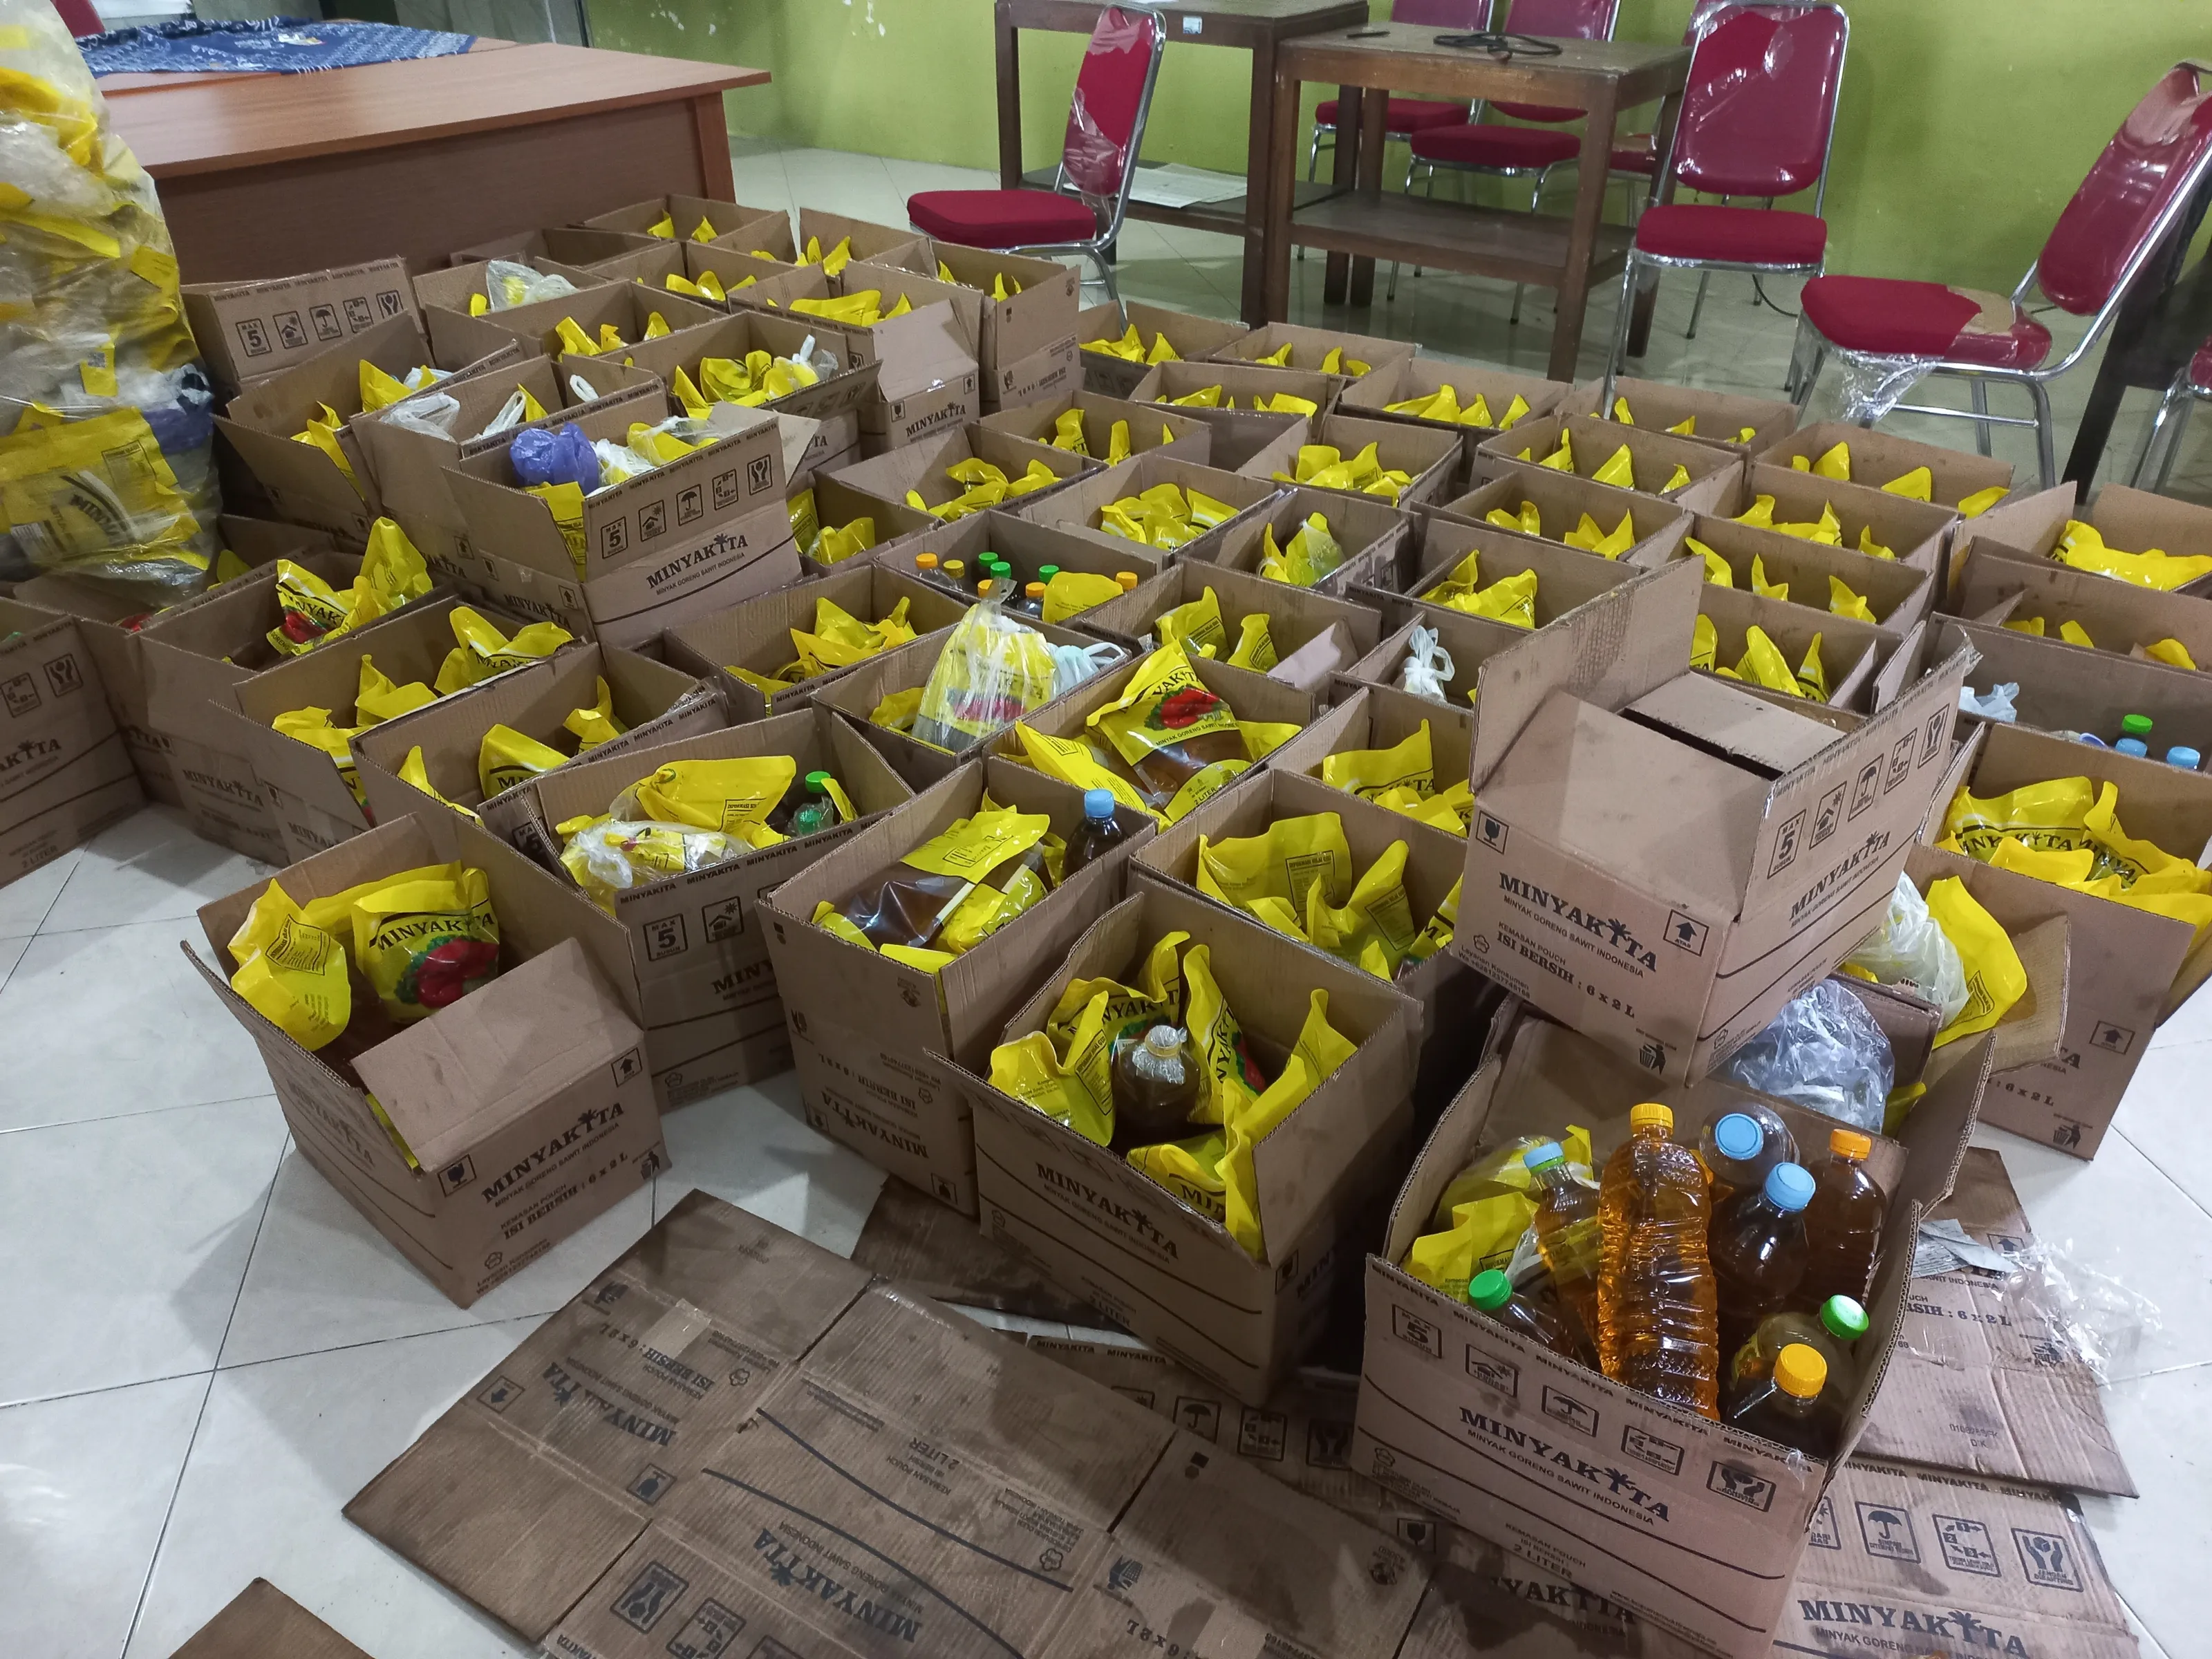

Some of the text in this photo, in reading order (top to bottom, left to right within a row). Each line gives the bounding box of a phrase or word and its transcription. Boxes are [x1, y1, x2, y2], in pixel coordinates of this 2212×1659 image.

[247, 330, 262, 347] 5
[906, 402, 966, 438] MINYAKITA
[588, 423, 778, 509] MINYAKITA MINYAKITA MINYAKITA MINYAKITA MINYAKITA
[606, 522, 622, 532] MAX
[609, 530, 621, 548] 5
[646, 533, 748, 589] MINYAKITA
[677, 572, 700, 588] GORENG
[701, 563, 718, 577] SAWIT
[504, 593, 573, 630] MINYAKITA
[776, 684, 816, 703] MINYAKITA
[588, 740, 630, 762] MINYAKITA
[634, 718, 673, 742] MINYAKITA
[678, 699, 716, 720] MINYAKITA
[1156, 734, 1178, 747] MINYAK
[1178, 727, 1202, 740] GORENG
[182, 769, 263, 807] MINYAKITA
[1200, 787, 1217, 803] LITER
[1781, 817, 1801, 834] MAX
[1779, 834, 1794, 861] 5
[620, 828, 853, 904] MINYAKITA MINYAKITA MINYAKITA MINYAKITA
[1790, 830, 1891, 921] MINYAKITA
[376, 911, 496, 953] MINYAKITA
[651, 919, 677, 932] MAX
[657, 927, 677, 950] 5
[1499, 872, 1657, 972] MINYAKITA
[1503, 895, 1644, 978] MINYAK GORENG SAWIT INDONESIA
[1498, 921, 1566, 966] KEMASAN POUCH
[1461, 944, 1530, 990] Layanan Konsumen
[1497, 931, 1635, 1019] ISI BERSIH 6 x 2 L
[2005, 1082, 2015, 1093] 6
[2031, 1091, 2042, 1102] 2
[2044, 1096, 2054, 1107] L
[822, 1091, 930, 1159] MINYAKITA
[481, 1103, 624, 1203] MINYAKITA
[494, 1123, 619, 1208] MINYAK GORENG SAWIT INDONESIA
[500, 1183, 567, 1230] KEMASAN POUCH
[504, 1221, 525, 1239] ISI
[527, 1185, 579, 1226] BERSIH
[588, 1174, 597, 1184] 6
[619, 1152, 628, 1161] L
[1035, 1162, 1179, 1260] MINYAKITA
[1042, 1183, 1071, 1206] MINYAK
[1909, 1295, 1929, 1303] UCH
[599, 1324, 609, 1334] L
[1401, 1310, 1432, 1331] MAX
[1407, 1320, 1429, 1343] 5
[1957, 1311, 2013, 1327] 6 2 L
[630, 1338, 639, 1349] 6
[1037, 1339, 1168, 1366] MINYAKITA MINYAKITA
[644, 1347, 694, 1378] BERSIH
[1371, 1264, 1439, 1306] MINYAKITA
[1453, 1310, 1526, 1353] MINYAKITA
[1535, 1355, 1614, 1397] MINYAKITA
[1626, 1398, 1709, 1436] MINYAKITA
[1723, 1437, 1812, 1473] MINYAKA
[691, 1374, 715, 1391] ISI
[909, 1437, 959, 1470] 2 LITER
[1459, 1407, 1669, 1521] MINYAKITA
[886, 1456, 952, 1496] KEMASAN POUCH
[1468, 1428, 1655, 1525] MINYAK GORENG SAWIT INDONESIA
[1917, 1472, 1989, 1492] MINYAKITA
[779, 1521, 890, 1594] GORENG SAWIT INDONESIA
[1505, 1522, 1586, 1568] KEMASAN POUCH
[1512, 1543, 1573, 1579] 2 LITER
[753, 1528, 922, 1643] MINYAKITA
[1126, 1619, 1140, 1635] L
[1140, 1627, 1153, 1642] 2
[1797, 1599, 2028, 1658] MINYAKITA
[1816, 1628, 1859, 1644] MINYAK
[1862, 1635, 1913, 1654] GORENG
[1168, 1644, 1180, 1657] 6
